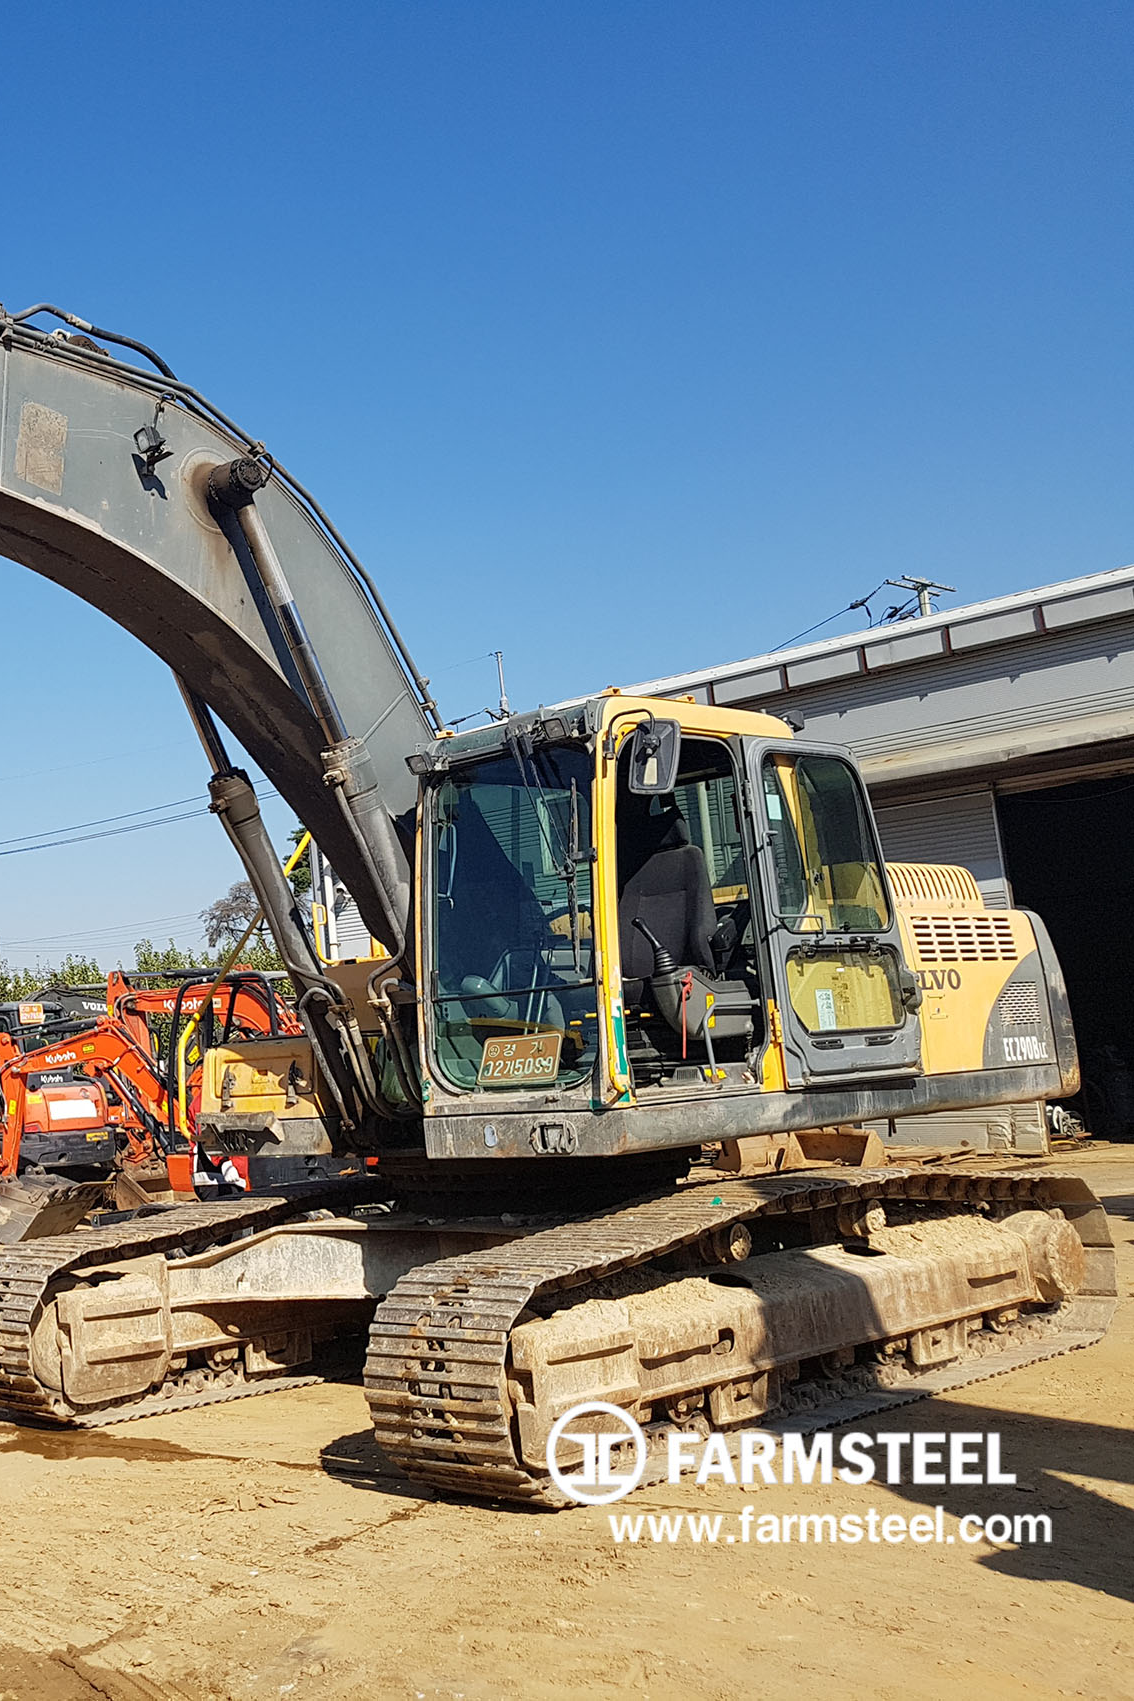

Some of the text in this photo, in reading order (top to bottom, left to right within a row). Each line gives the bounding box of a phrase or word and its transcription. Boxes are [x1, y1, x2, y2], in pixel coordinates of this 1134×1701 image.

[916, 968, 961, 990] LVO
[82, 1001, 108, 1012] VOLV
[44, 1050, 77, 1064] Kubota
[40, 1074, 64, 1083] Kubota
